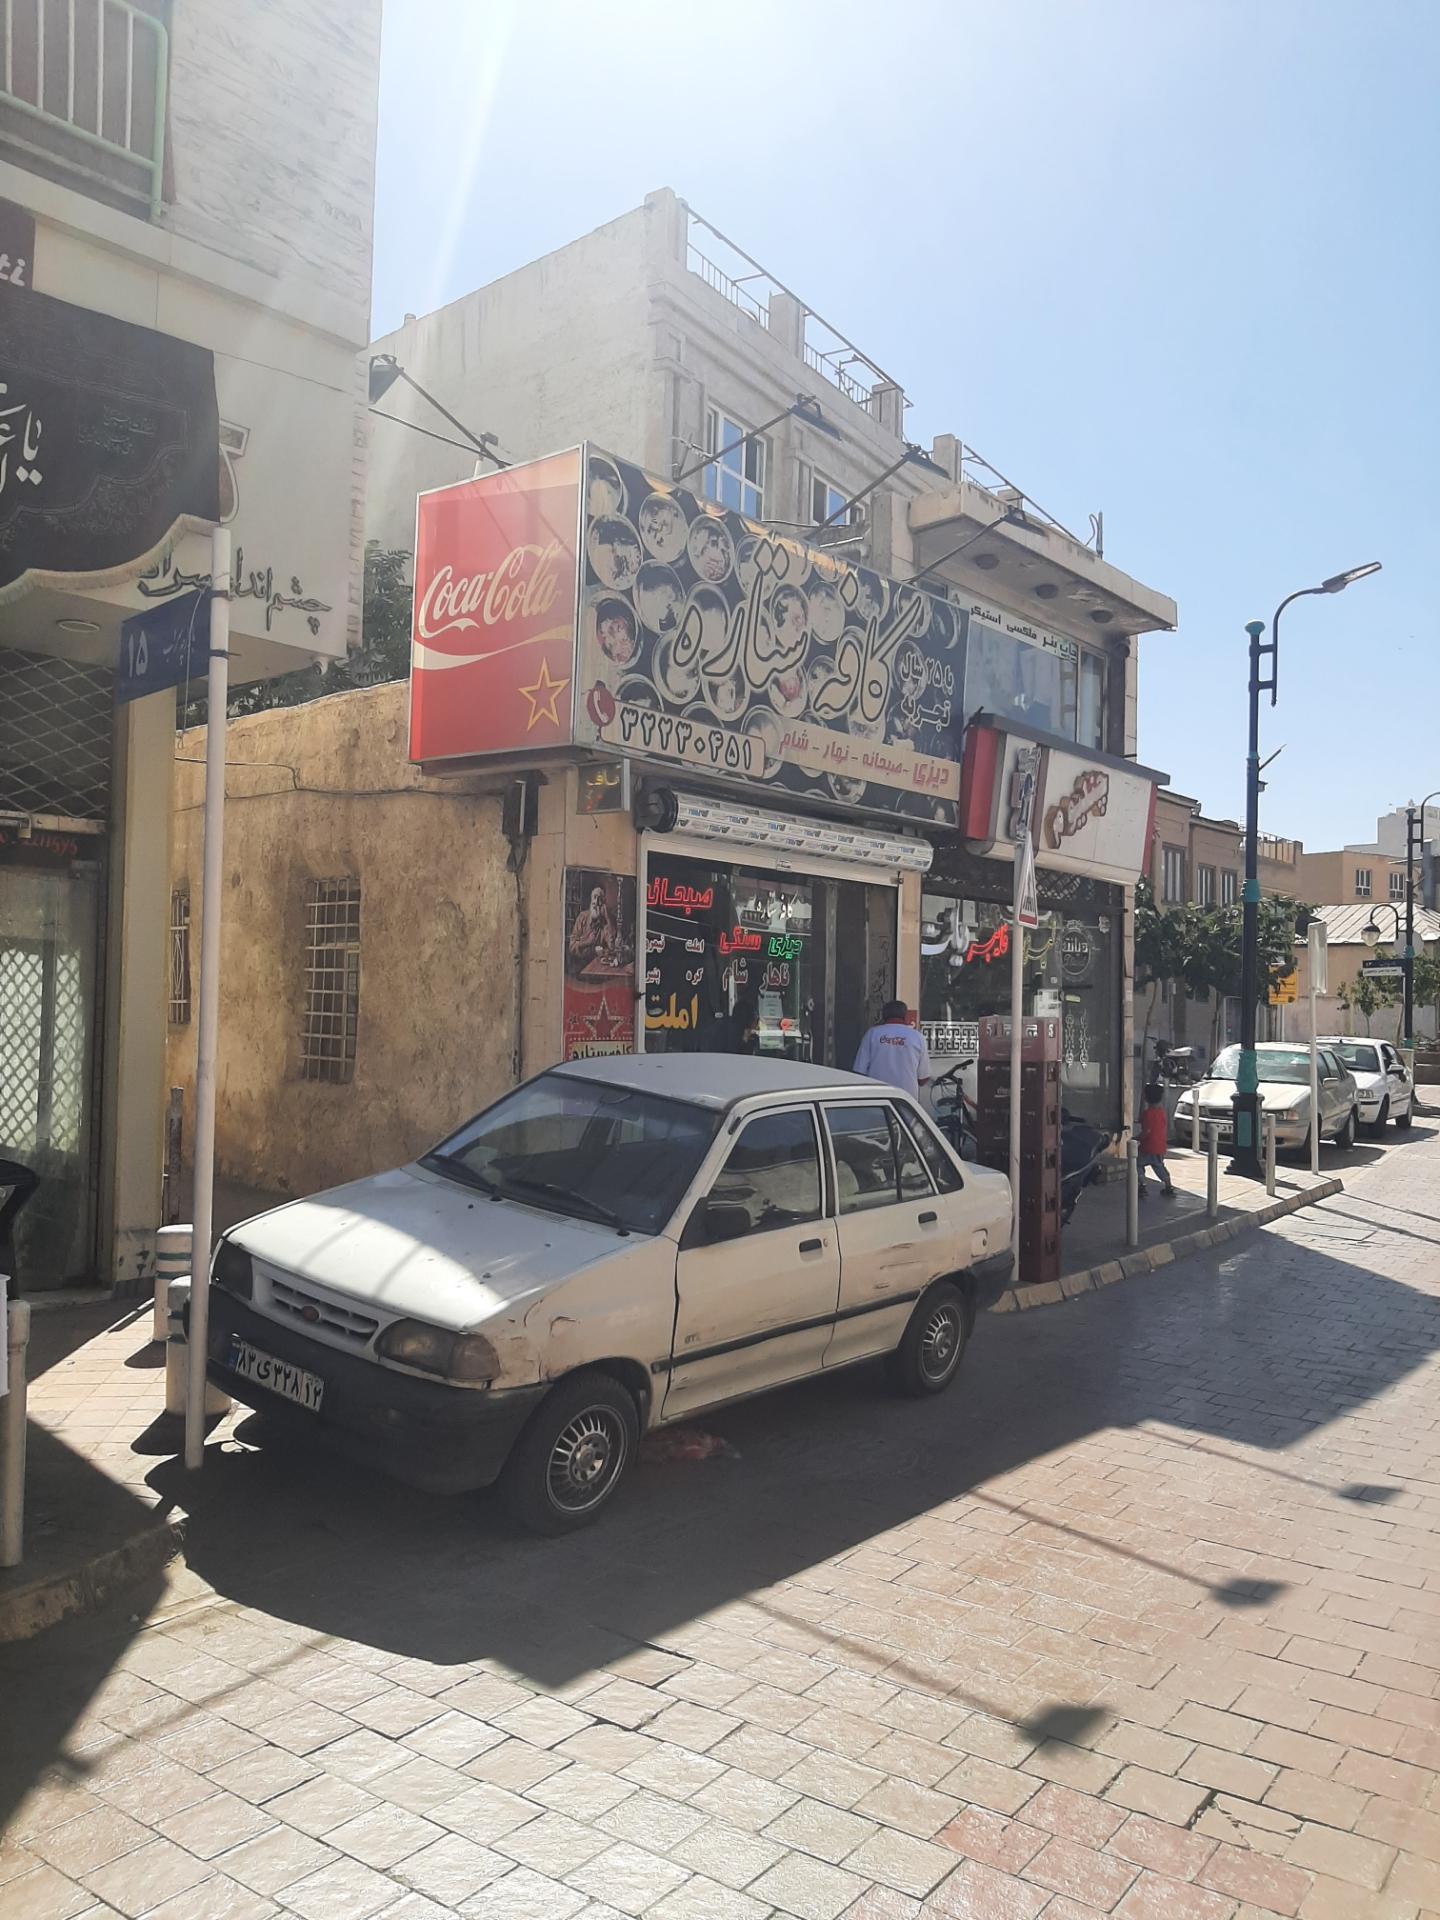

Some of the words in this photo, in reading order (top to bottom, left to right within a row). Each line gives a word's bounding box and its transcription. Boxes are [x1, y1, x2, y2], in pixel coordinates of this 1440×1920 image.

[266, 576, 333, 636] چشم
[673, 538, 809, 690] ستاره
[128, 630, 149, 678] ۱۵
[813, 568, 923, 723] کافه
[901, 651, 924, 682] سال
[926, 657, 943, 688] ۲۵
[901, 695, 952, 732] تجربه
[620, 706, 752, 770] ۳۲۲۳۰۴۵۱
[778, 729, 809, 756] شام
[822, 740, 849, 765] نهار
[862, 751, 903, 776] صبحانه
[912, 759, 950, 789] دیزی
[645, 992, 699, 1030] املت
